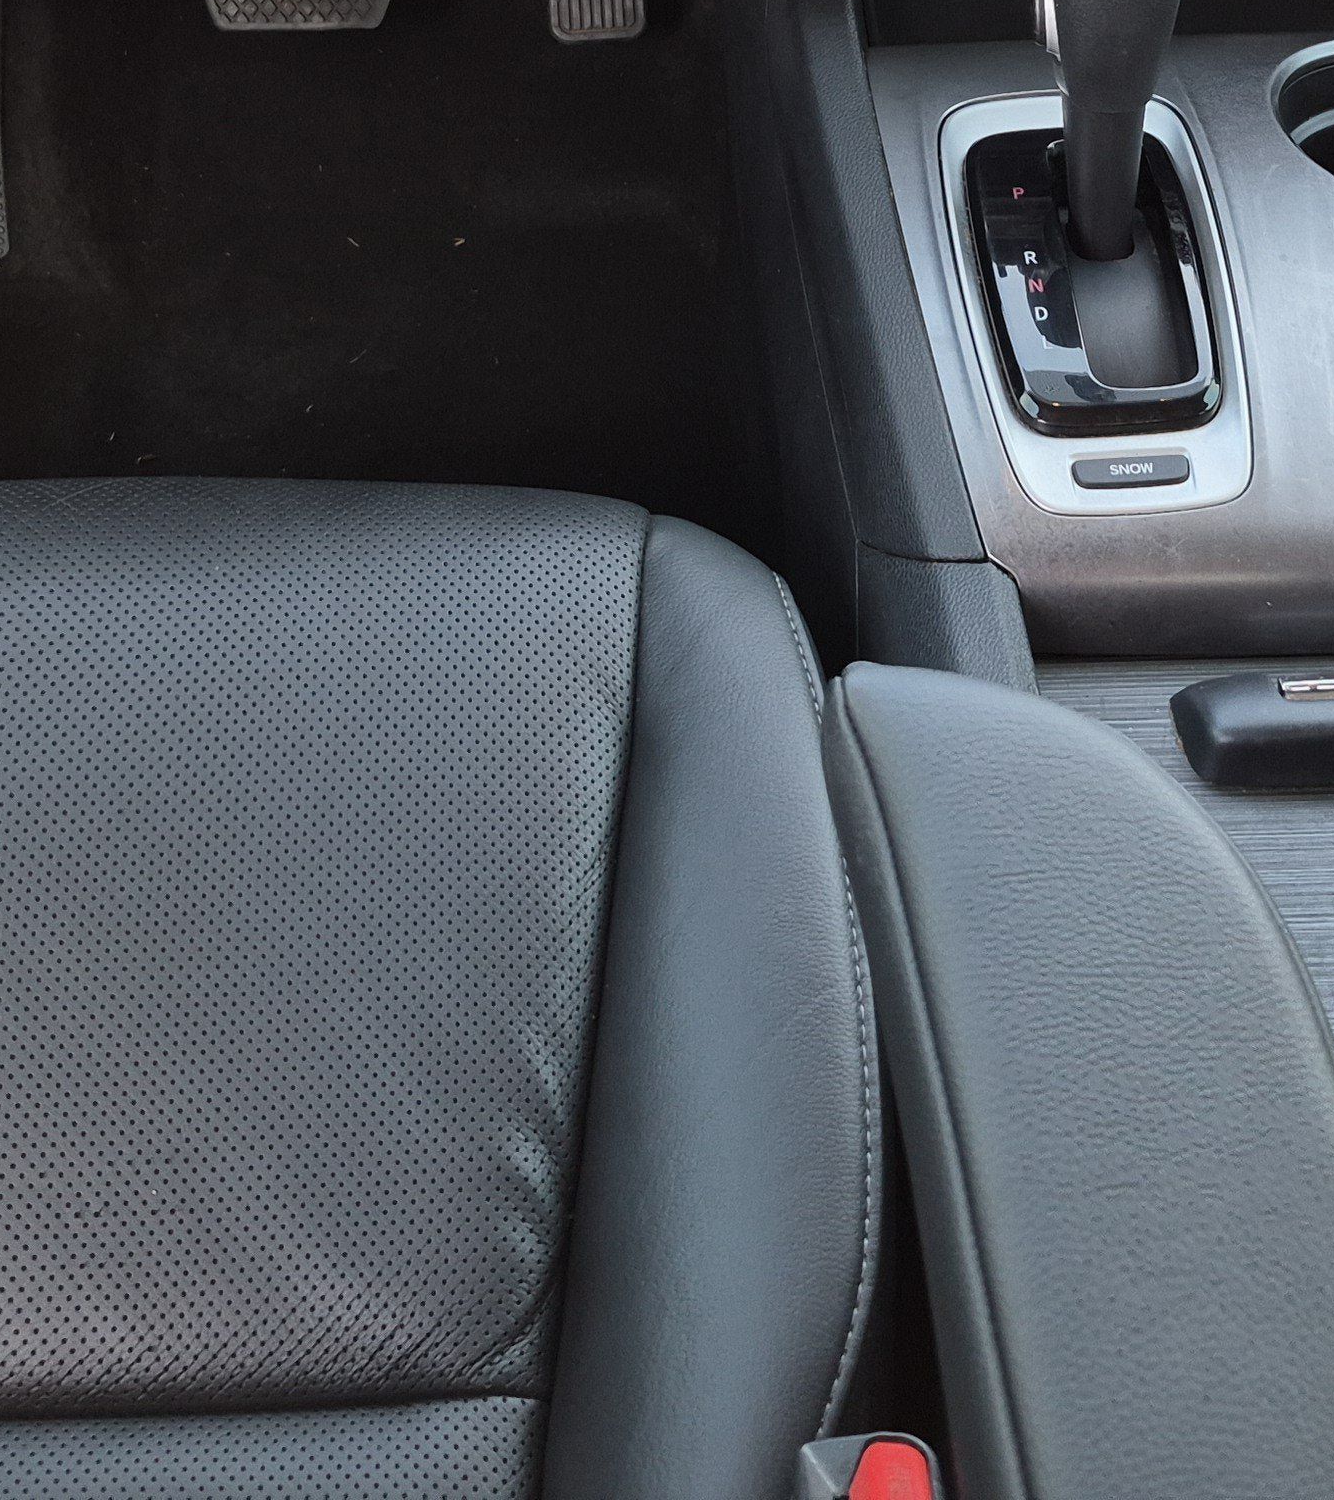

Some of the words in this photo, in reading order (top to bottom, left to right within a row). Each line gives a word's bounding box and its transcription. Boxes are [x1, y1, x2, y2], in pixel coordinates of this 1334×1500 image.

[1013, 187, 1024, 200] P
[1024, 251, 1037, 265] R
[1029, 279, 1045, 293] N
[1034, 306, 1049, 321] D
[1109, 462, 1153, 476] SNOW
